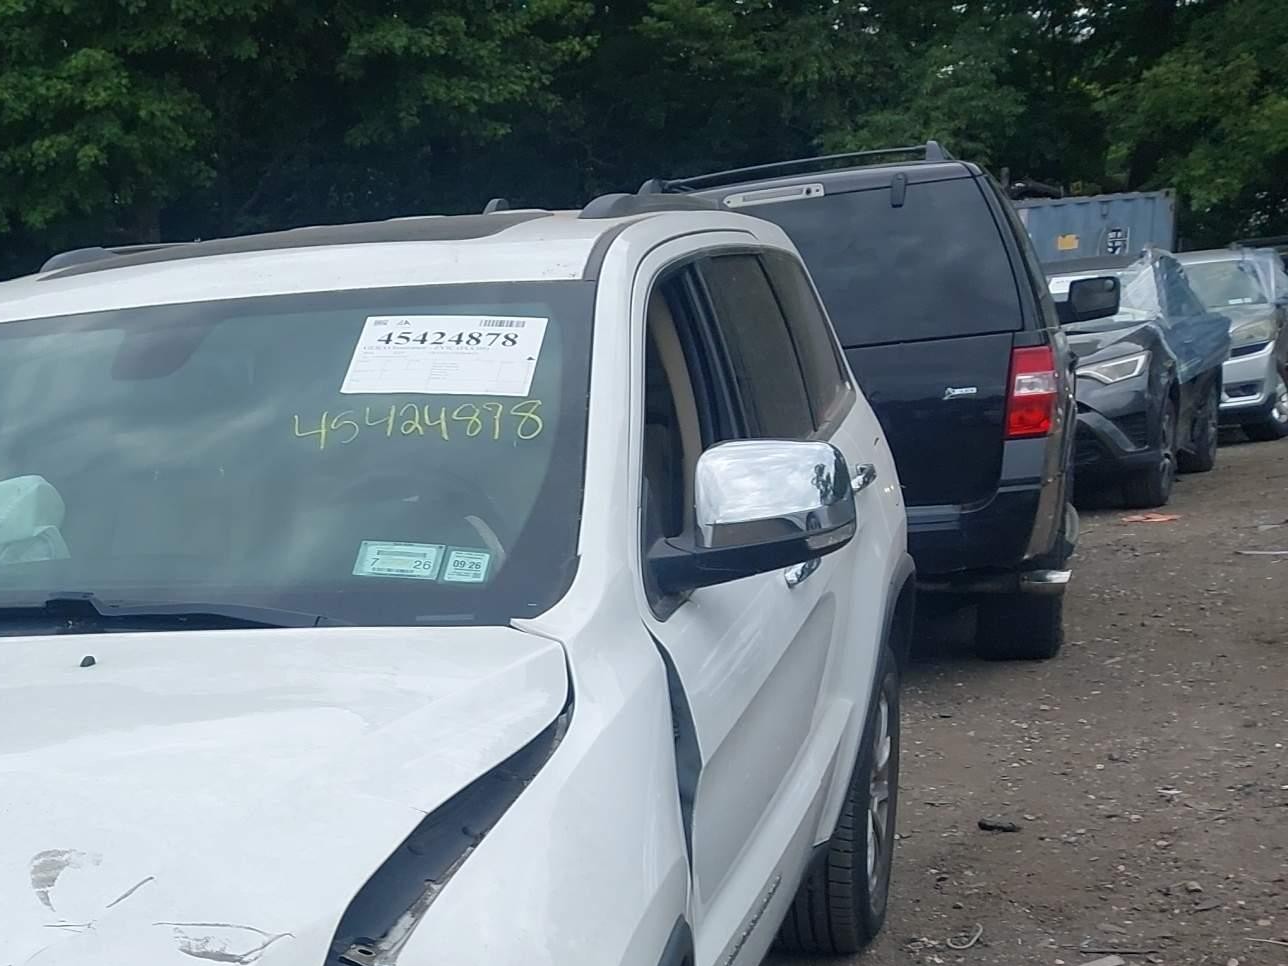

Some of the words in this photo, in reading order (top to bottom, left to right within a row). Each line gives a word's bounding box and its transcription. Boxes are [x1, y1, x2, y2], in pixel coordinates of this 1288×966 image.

[377, 331, 519, 347] 45424878
[294, 400, 543, 450] 45424878
[370, 558, 380, 567] 7
[412, 560, 433, 571] 26
